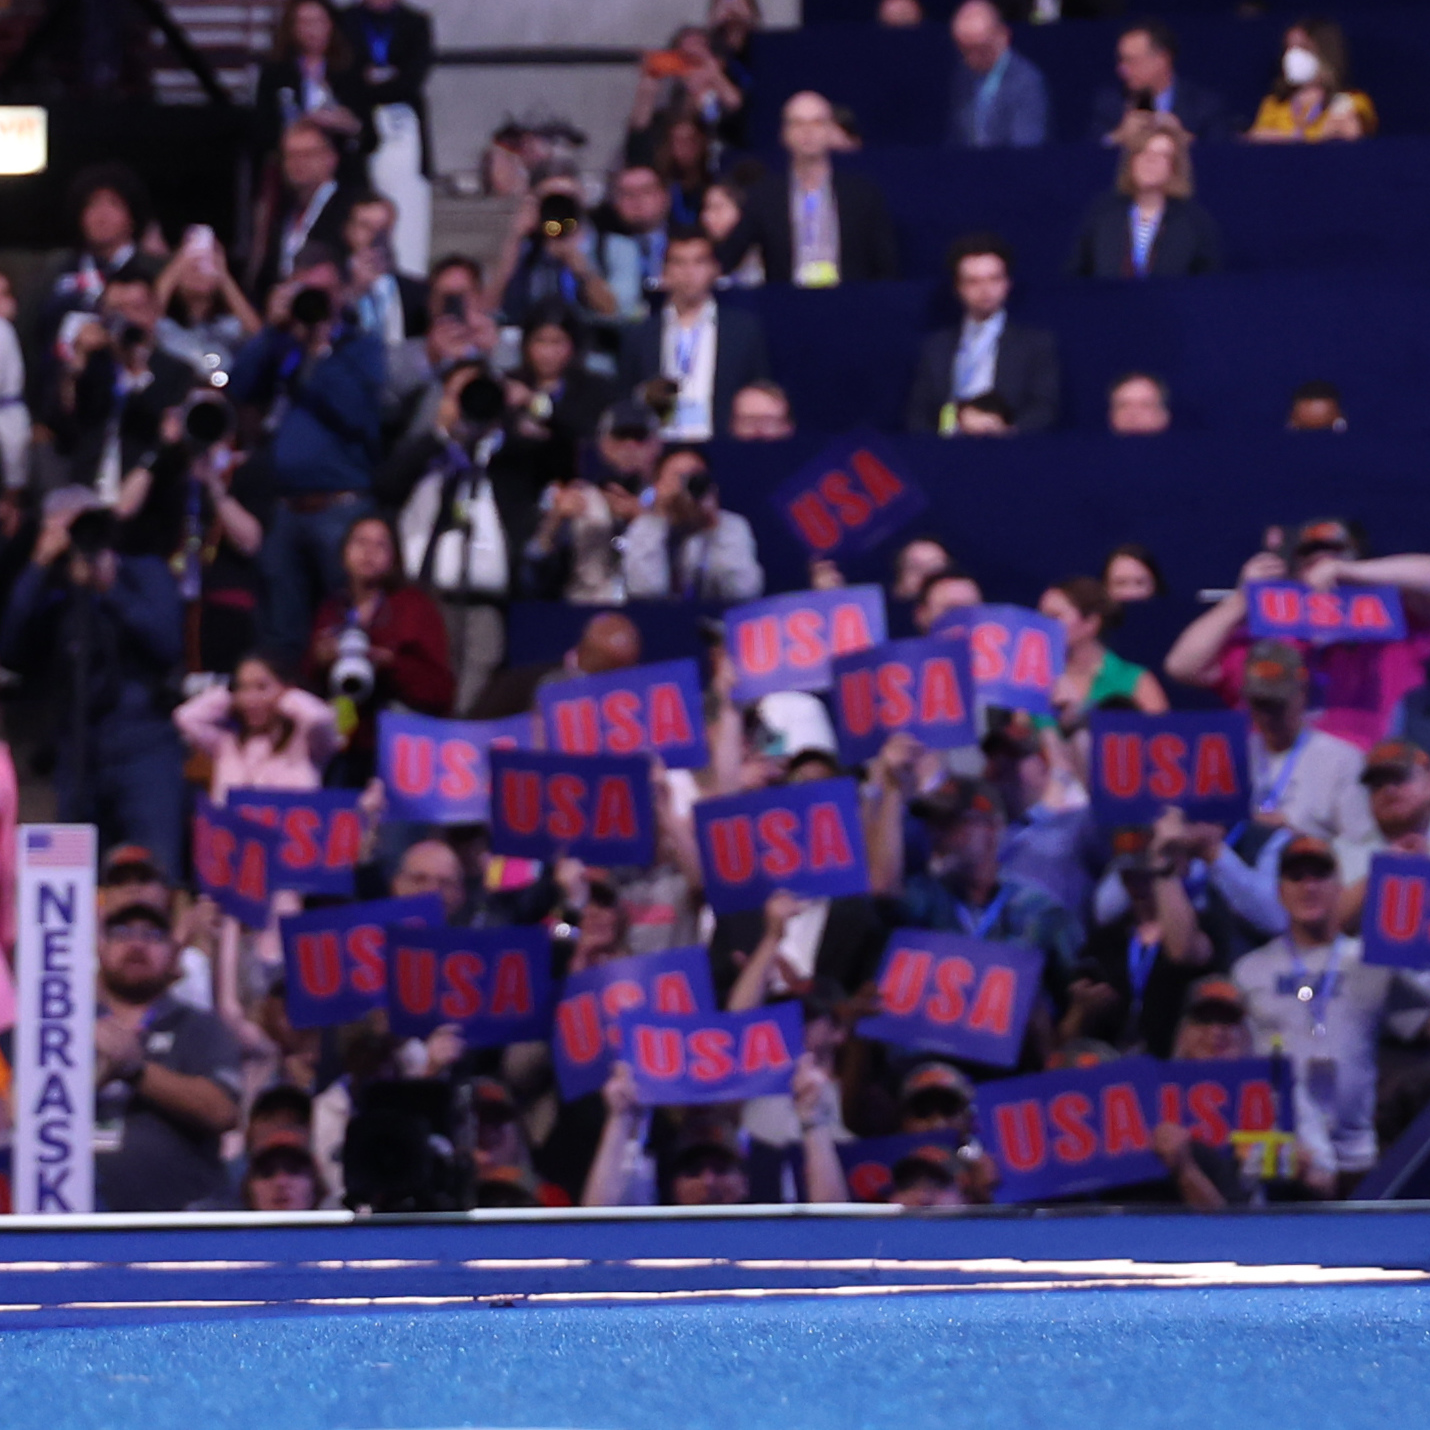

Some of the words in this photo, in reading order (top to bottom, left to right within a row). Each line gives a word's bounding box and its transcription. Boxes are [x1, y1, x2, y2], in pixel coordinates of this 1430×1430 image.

[789, 449, 904, 550] USA
[737, 603, 872, 674] USA
[1259, 588, 1393, 628] USA
[943, 622, 1051, 690] SA
[553, 682, 692, 756] USA
[840, 657, 966, 735] USA
[391, 733, 519, 801] US
[1102, 732, 1237, 800] USA
[240, 804, 362, 869] SA
[502, 769, 638, 841] USA
[708, 802, 853, 886] USA
[294, 923, 388, 999] US
[394, 947, 532, 1019] USA
[879, 948, 1017, 1037] USA
[633, 1019, 792, 1081] USA
[995, 1082, 1150, 1171] USA
